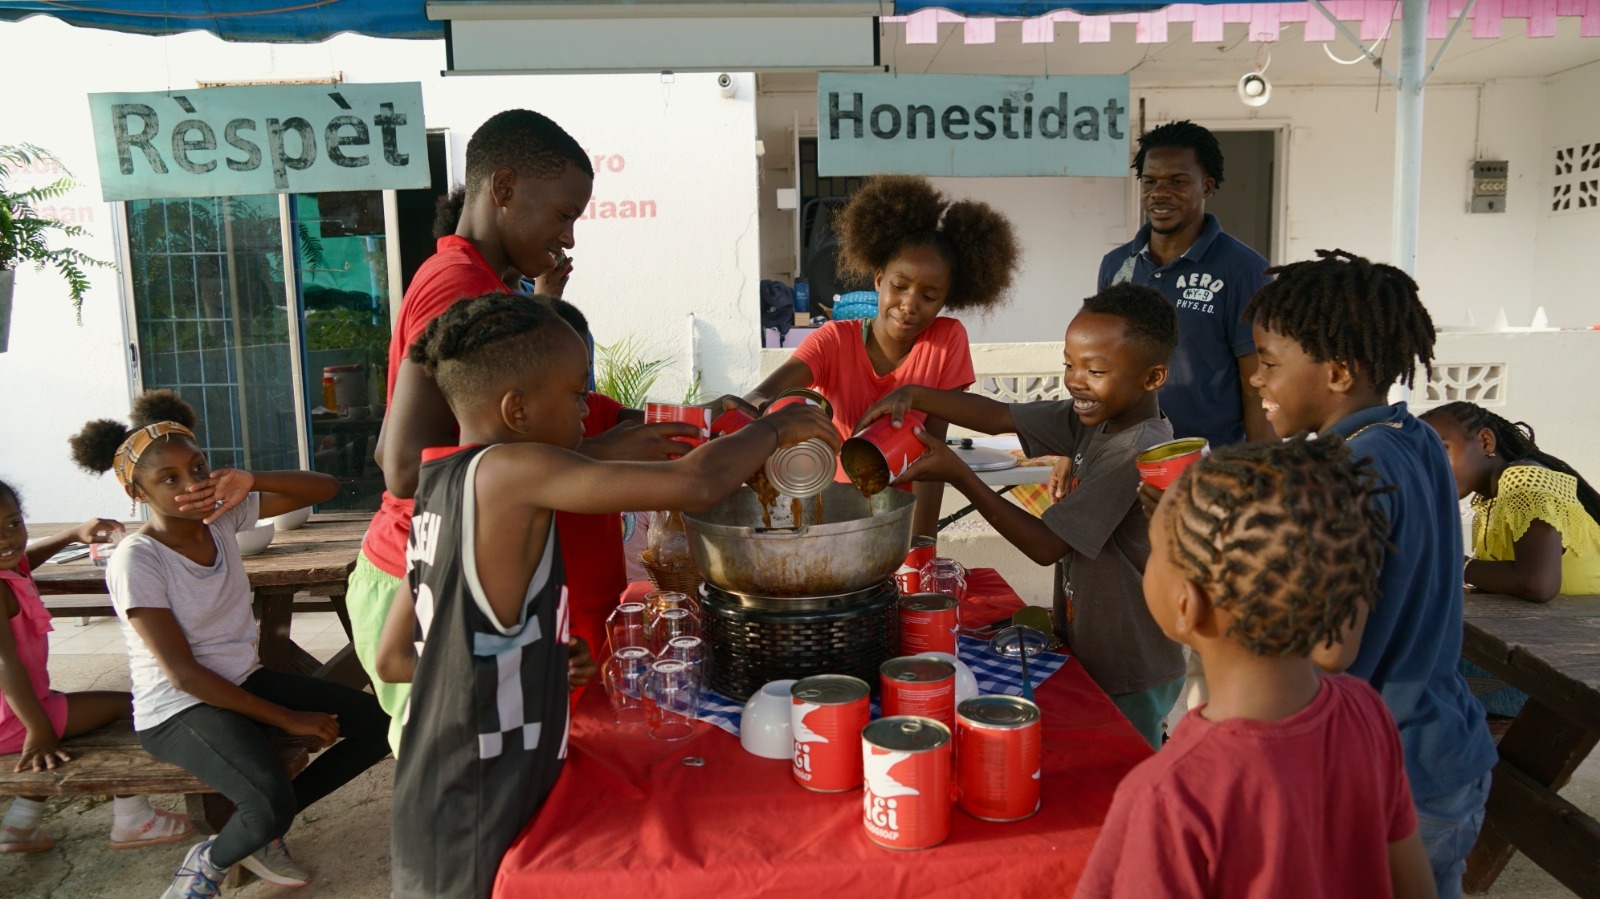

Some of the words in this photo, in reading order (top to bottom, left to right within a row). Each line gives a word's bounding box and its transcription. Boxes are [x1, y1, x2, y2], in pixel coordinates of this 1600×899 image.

[828, 91, 1124, 141] Honestidat
[110, 92, 410, 189] Rèspèt
[1176, 273, 1224, 293] AERO
[1176, 299, 1200, 311] PHYS.
[1201, 303, 1215, 314] ED.
